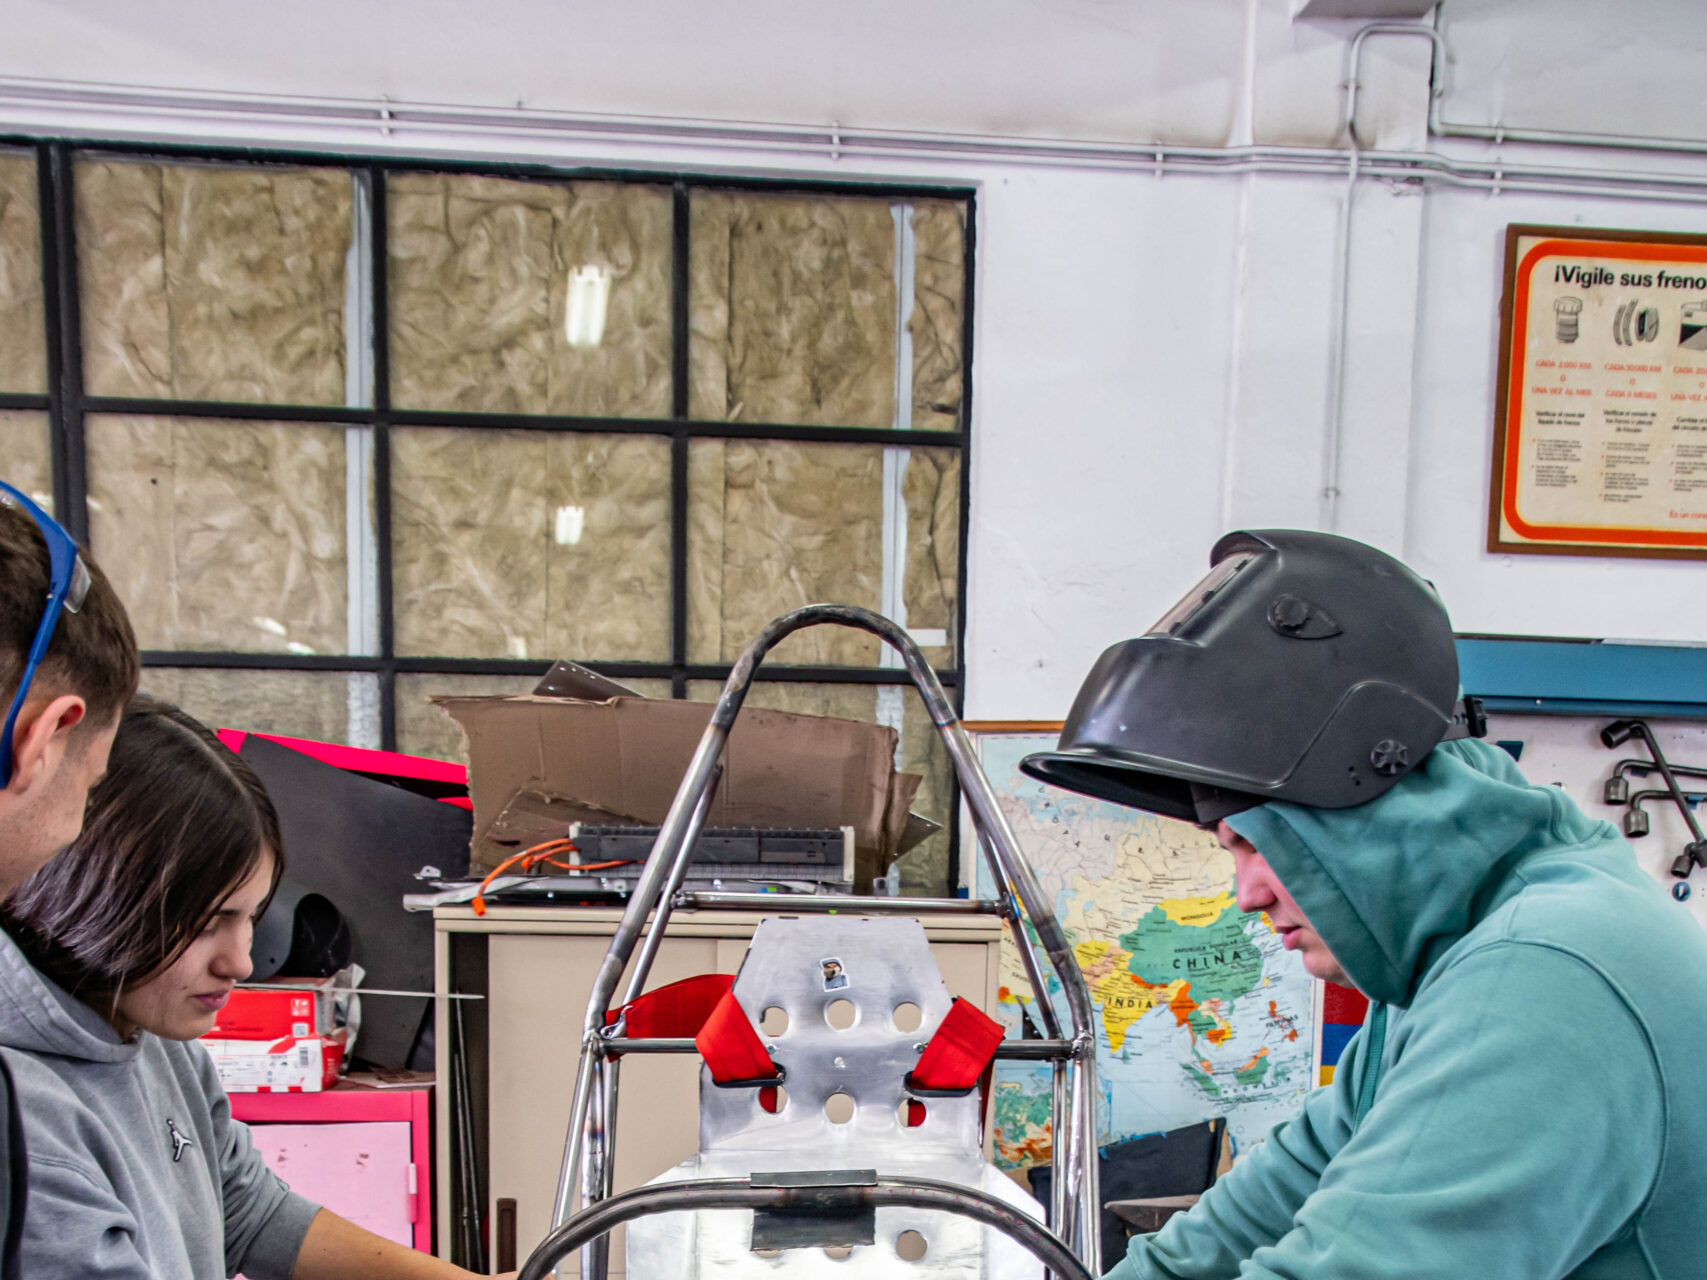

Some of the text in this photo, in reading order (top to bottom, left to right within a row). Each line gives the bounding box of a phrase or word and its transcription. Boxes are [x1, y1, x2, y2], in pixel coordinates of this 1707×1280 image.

[1620, 273, 1652, 287] sus
[1657, 270, 1707, 289] freno
[1172, 950, 1242, 969] CHINA
[1107, 997, 1153, 1009] INDIA
